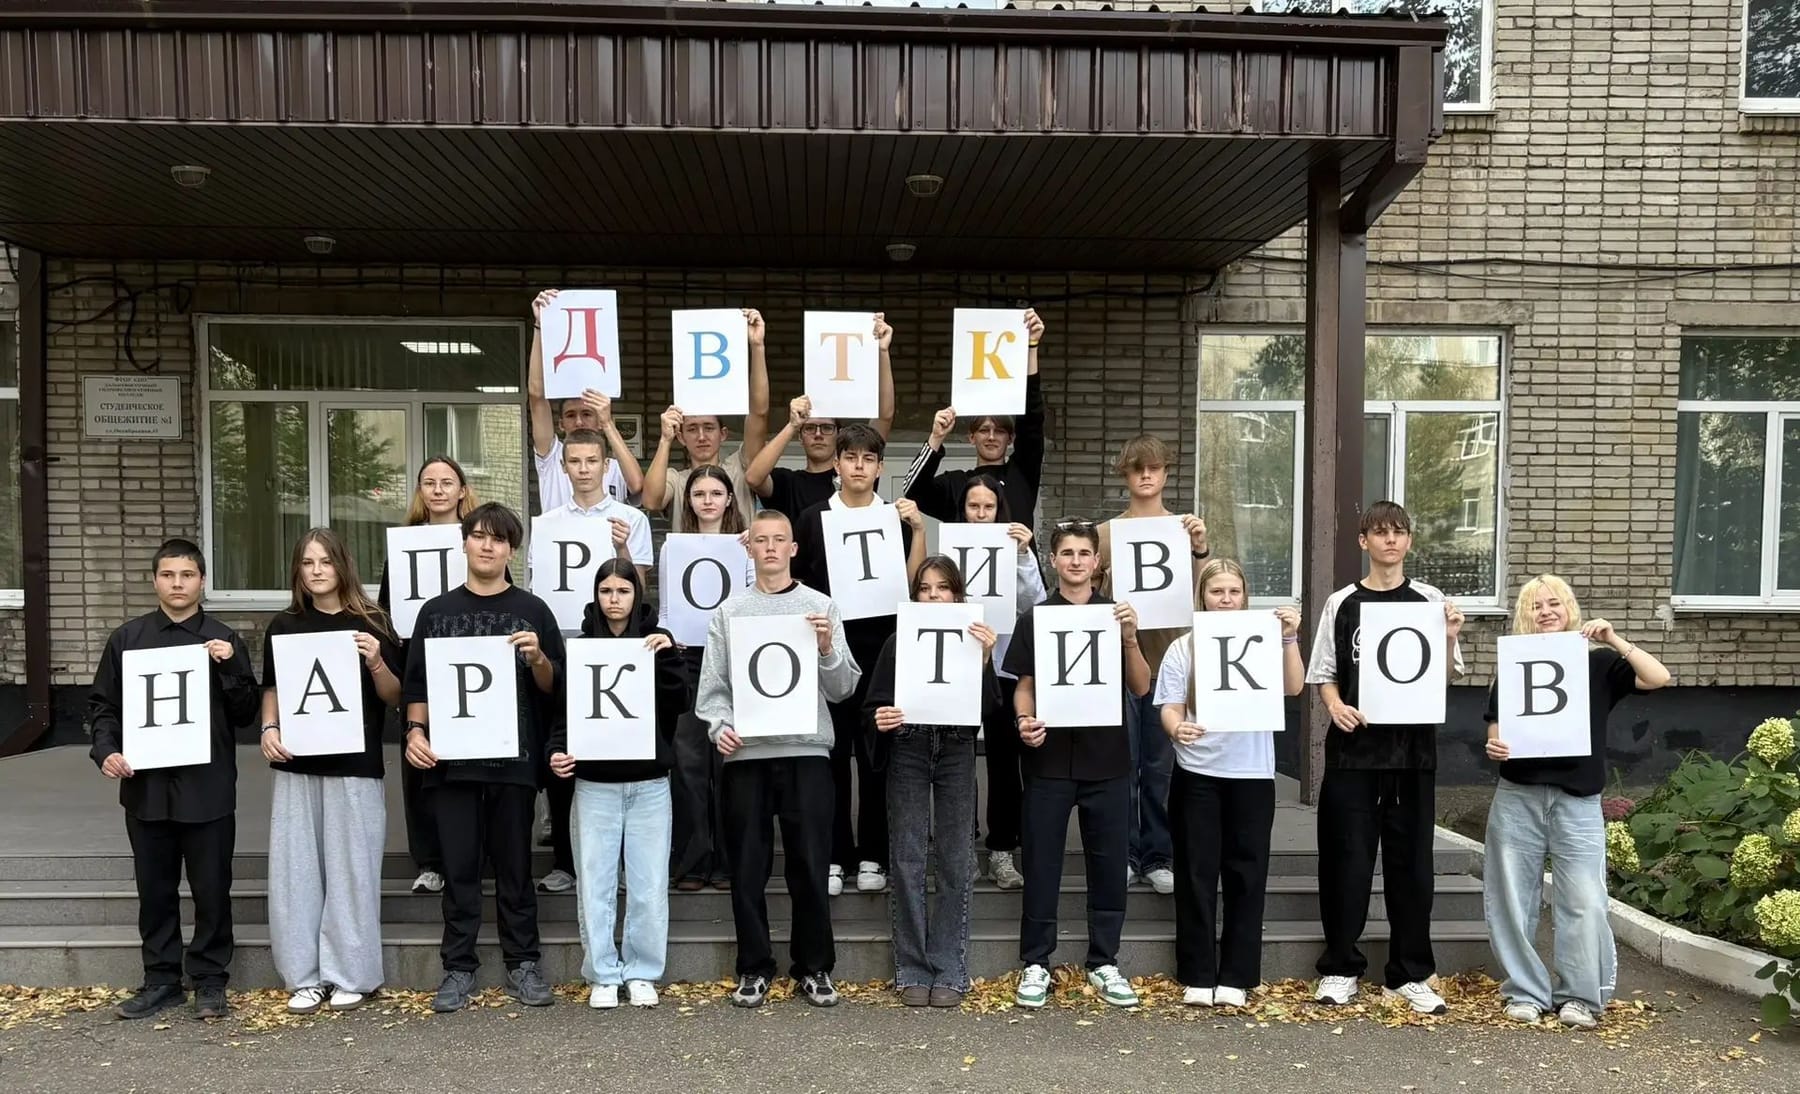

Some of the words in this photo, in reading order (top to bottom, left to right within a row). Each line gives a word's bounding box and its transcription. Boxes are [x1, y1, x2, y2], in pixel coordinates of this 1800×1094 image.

[553, 307, 606, 374] Д
[687, 331, 731, 380] В
[819, 332, 865, 381] Т
[968, 330, 1017, 381] К
[94, 415, 158, 425] ОБЩЕЖИТИЕ
[161, 416, 172, 425] №1
[100, 402, 164, 411] СТУДЕНЧЕСКОЕ
[401, 547, 455, 601] П
[551, 540, 592, 592] Р
[842, 528, 885, 582] Т
[952, 546, 1005, 598] И
[1126, 540, 1174, 593] В
[681, 557, 732, 611] О
[748, 641, 802, 699] О
[916, 627, 964, 685] Т
[1049, 629, 1108, 687] И
[1211, 634, 1268, 692] К
[1376, 626, 1432, 685] О
[138, 669, 196, 729] Н
[292, 657, 350, 716] А
[448, 662, 493, 719] Р
[584, 663, 639, 720] К
[1515, 660, 1568, 717] В
